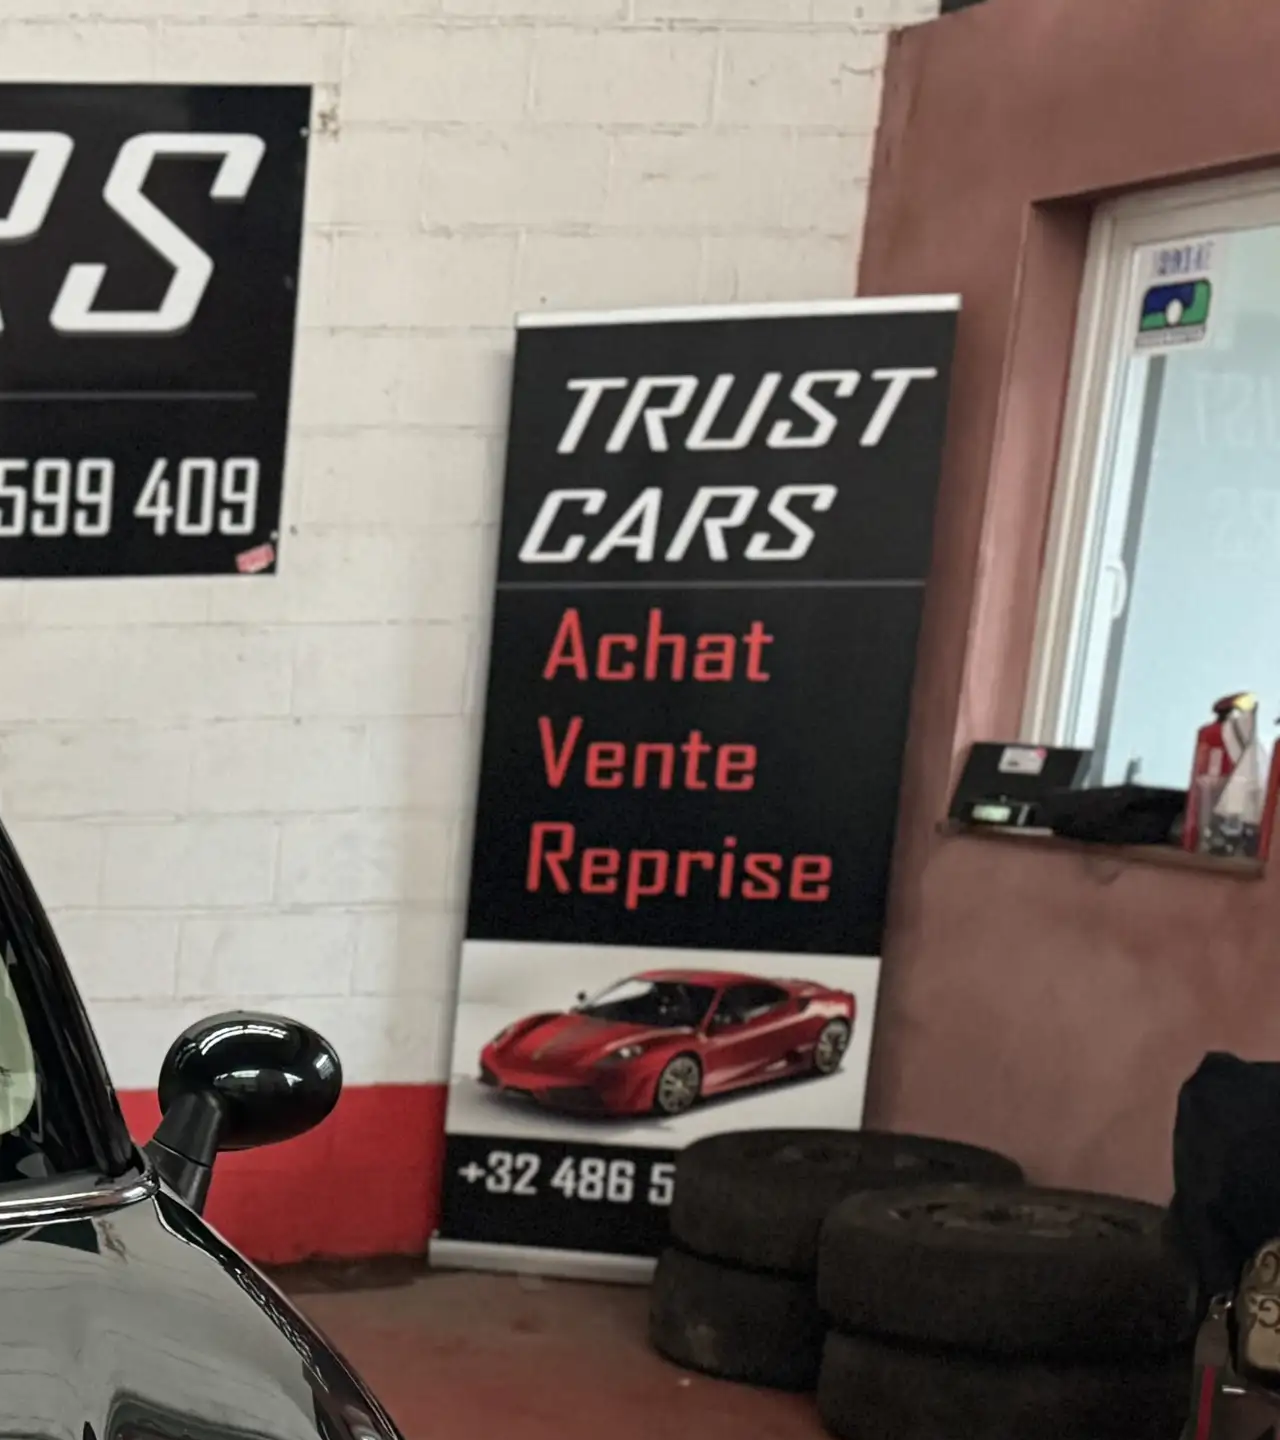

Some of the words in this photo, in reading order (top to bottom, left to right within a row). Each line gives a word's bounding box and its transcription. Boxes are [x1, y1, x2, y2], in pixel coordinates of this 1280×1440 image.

[556, 366, 939, 454] TRUST
[132, 457, 261, 537] 409
[517, 482, 840, 564] CARS
[542, 608, 773, 683] Achat
[537, 716, 759, 792] Vente
[524, 821, 833, 911] Reprise
[458, 1151, 541, 1195] +32
[550, 1156, 636, 1203] 486
